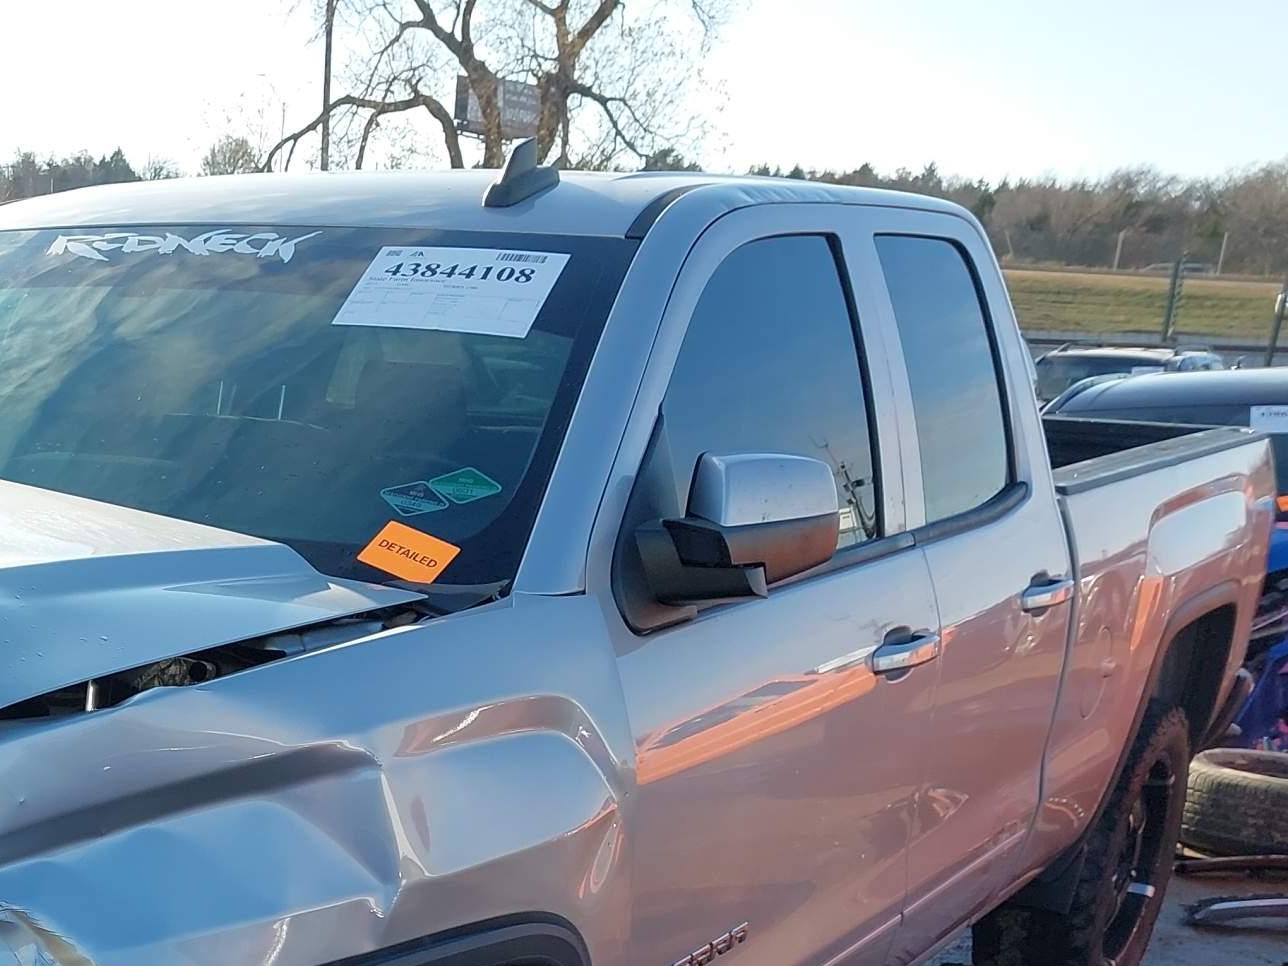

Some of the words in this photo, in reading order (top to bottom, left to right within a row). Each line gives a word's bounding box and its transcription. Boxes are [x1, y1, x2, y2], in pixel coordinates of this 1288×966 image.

[46, 229, 323, 263] REDNECK
[384, 262, 536, 284] 43844108
[378, 539, 438, 569] DETAILED
